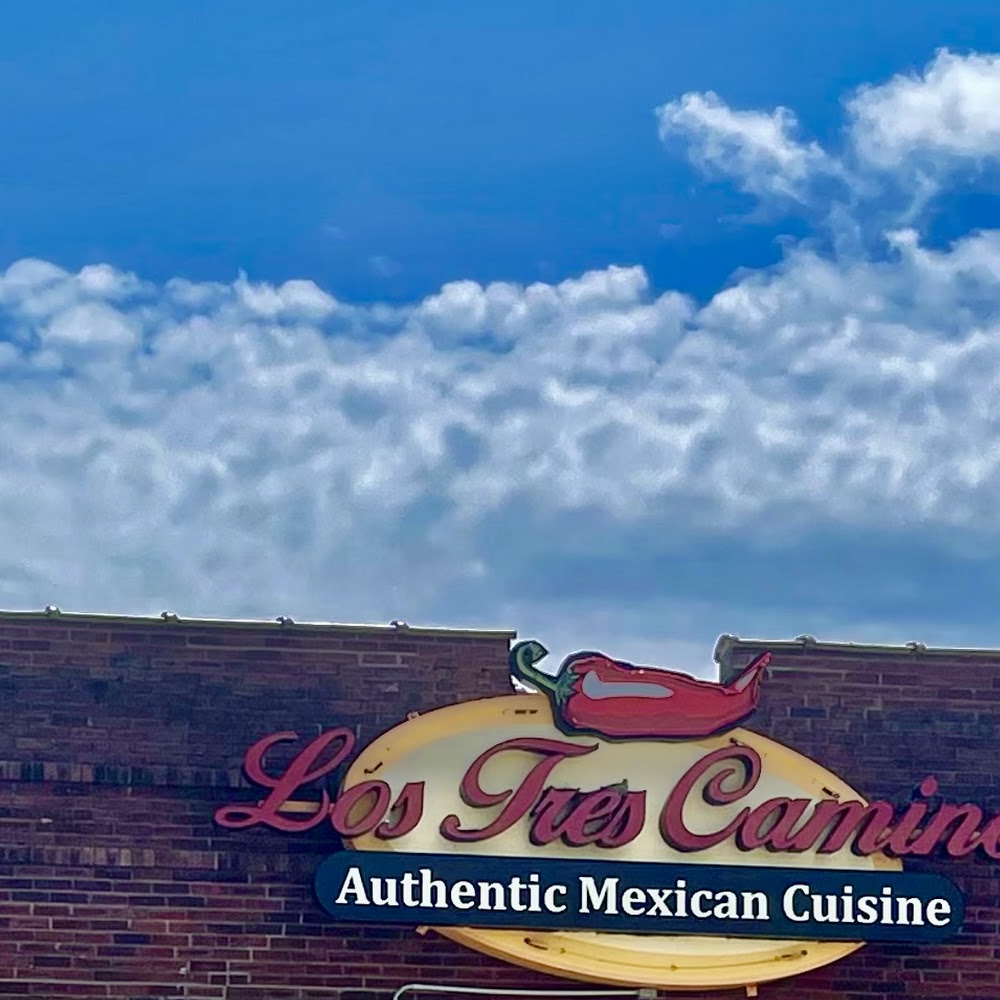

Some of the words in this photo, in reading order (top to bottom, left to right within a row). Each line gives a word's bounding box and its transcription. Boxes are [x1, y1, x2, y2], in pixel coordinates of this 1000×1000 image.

[214, 727, 426, 838] Los
[439, 737, 645, 849] Tres
[335, 867, 567, 913] Authentic
[578, 875, 770, 922] Mexican
[782, 884, 952, 926] Cuisine
